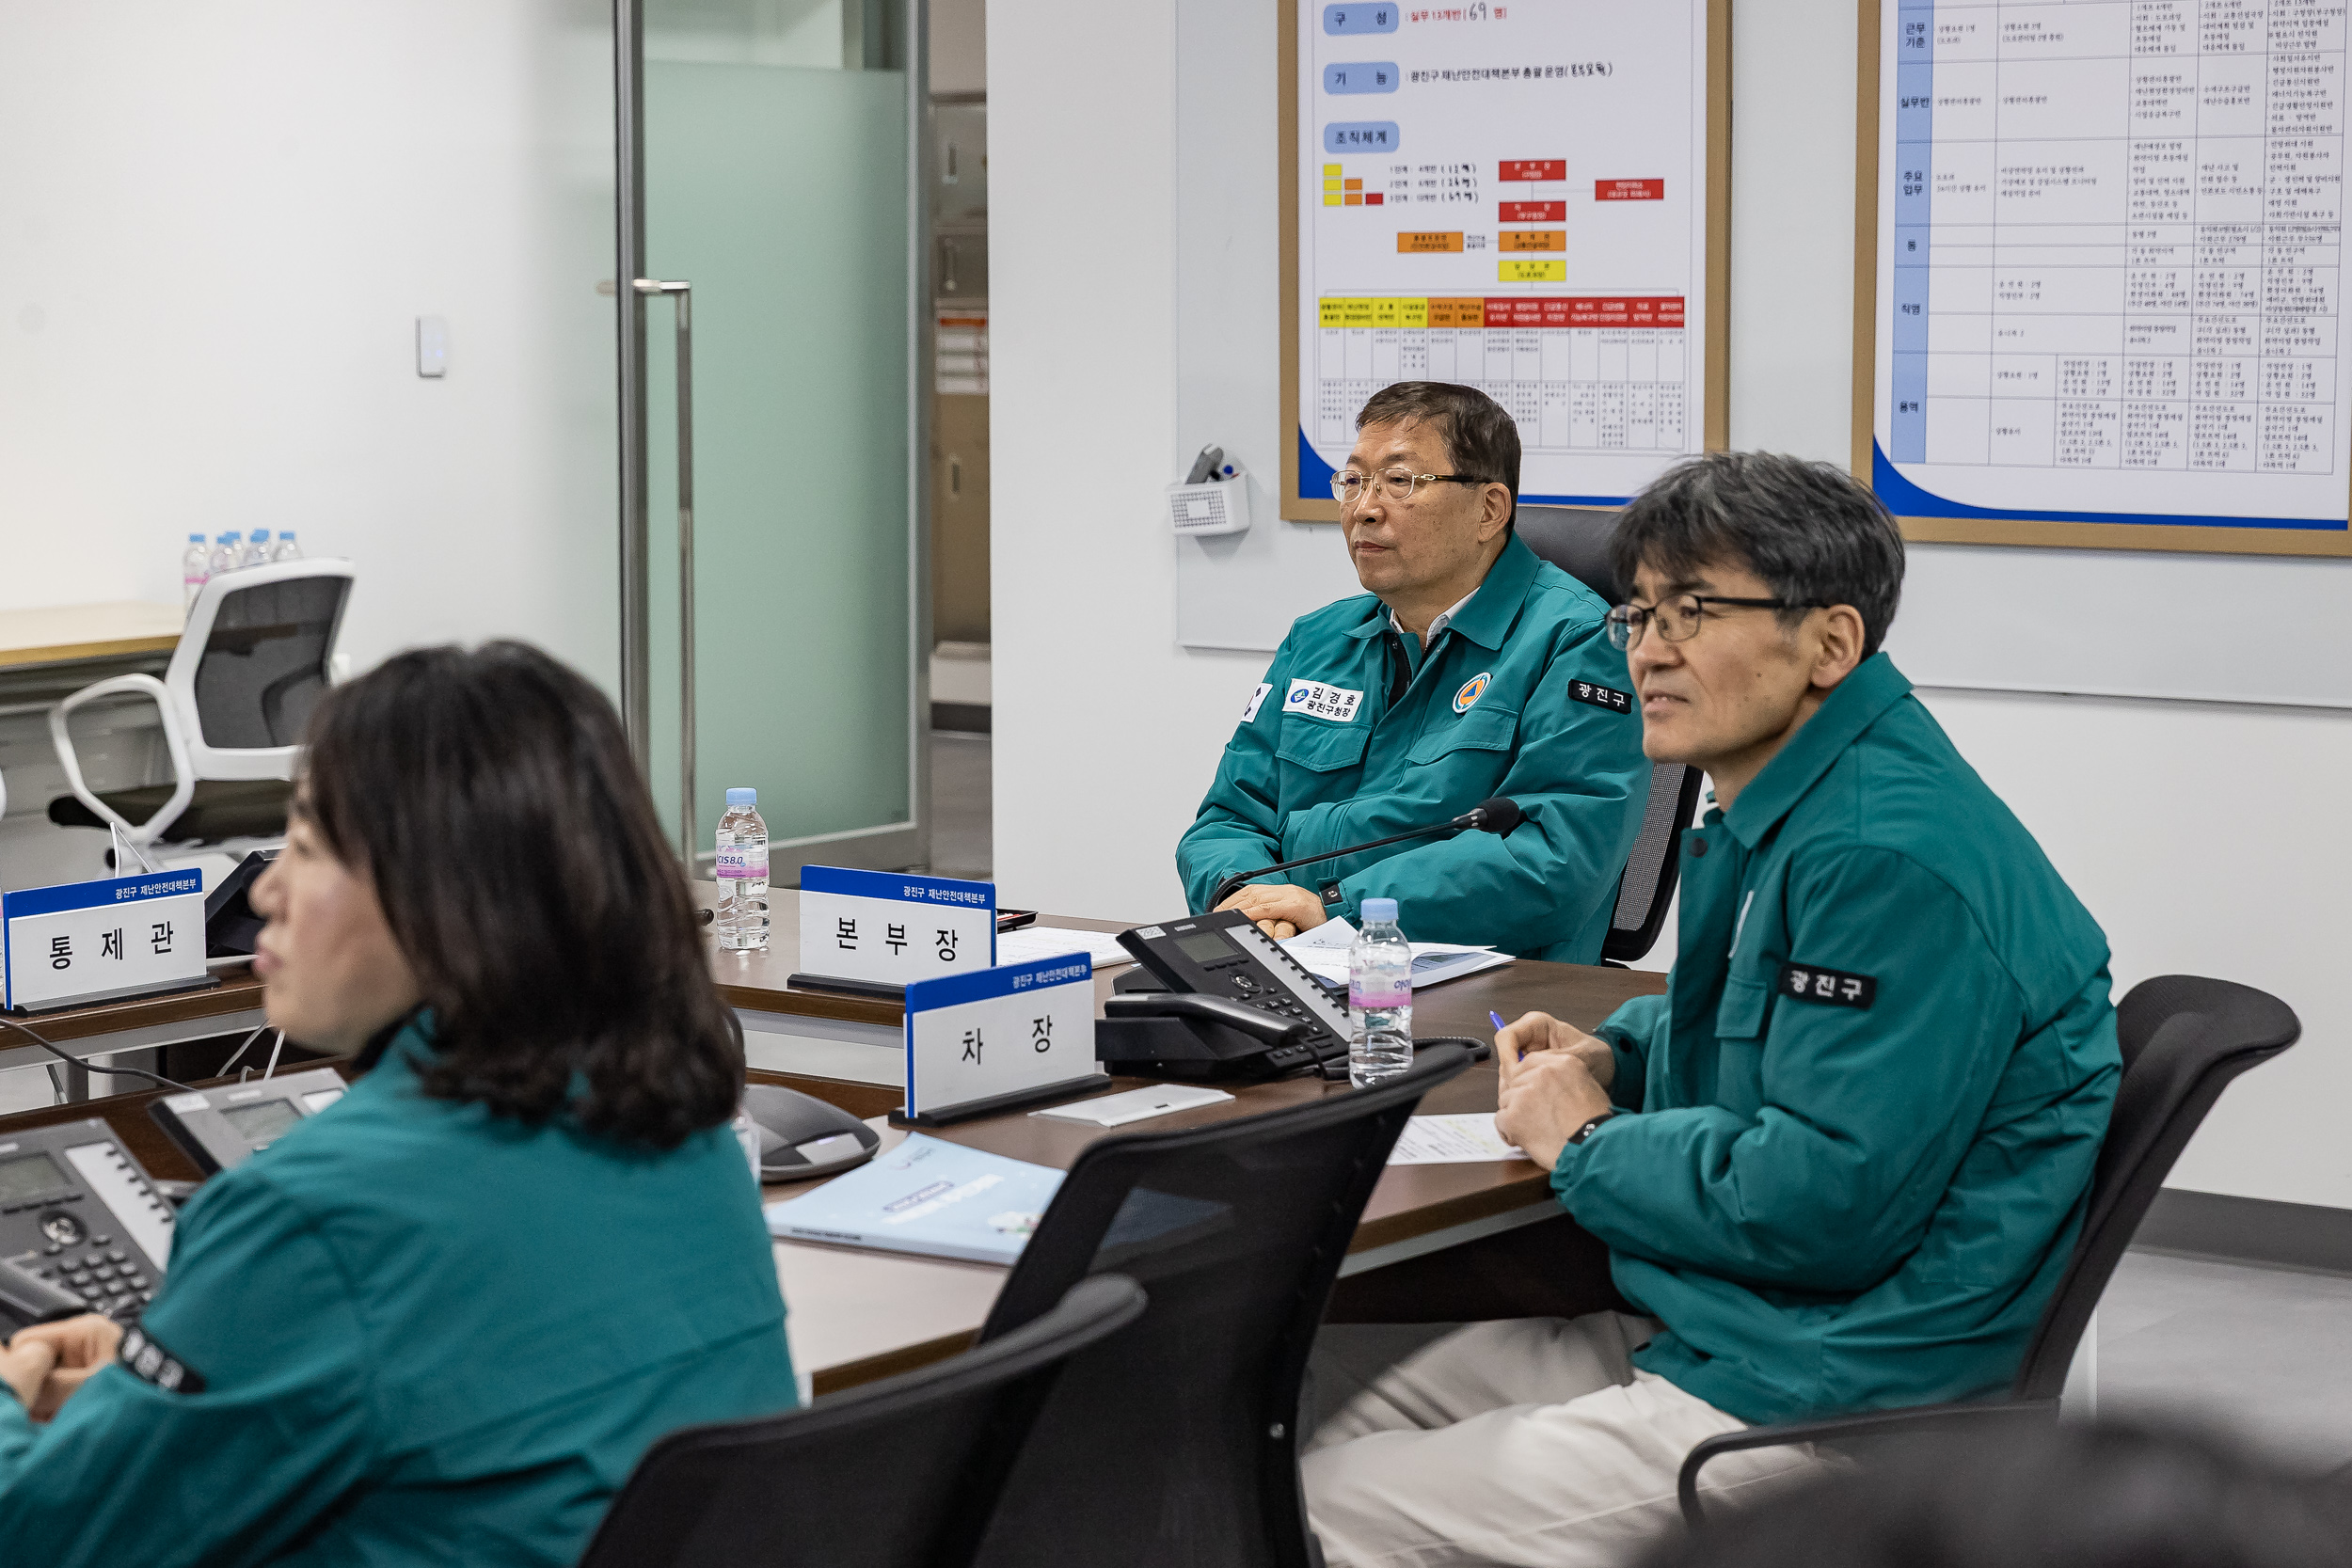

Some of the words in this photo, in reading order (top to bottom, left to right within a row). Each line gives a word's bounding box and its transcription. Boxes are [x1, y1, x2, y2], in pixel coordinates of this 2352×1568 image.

[1906, 22, 1926, 36] 근무
[1906, 37, 1925, 48] 기준
[1900, 95, 1930, 109] 실무반
[1336, 130, 1387, 144] 조직체계
[1903, 170, 1923, 182] 주요
[1903, 184, 1922, 197] 업무
[1579, 683, 1625, 707] 광진구
[1306, 699, 1351, 718] 광진구청장
[115, 886, 137, 899] 광진구
[140, 878, 197, 895] 재난안전대책본부
[903, 885, 925, 898] 광진구
[928, 888, 986, 905] 재난안전대책본부
[1012, 974, 1033, 990] 광진구
[1035, 966, 1088, 985] 재난안전대책본부
[1789, 970, 1862, 1001] 광진구
